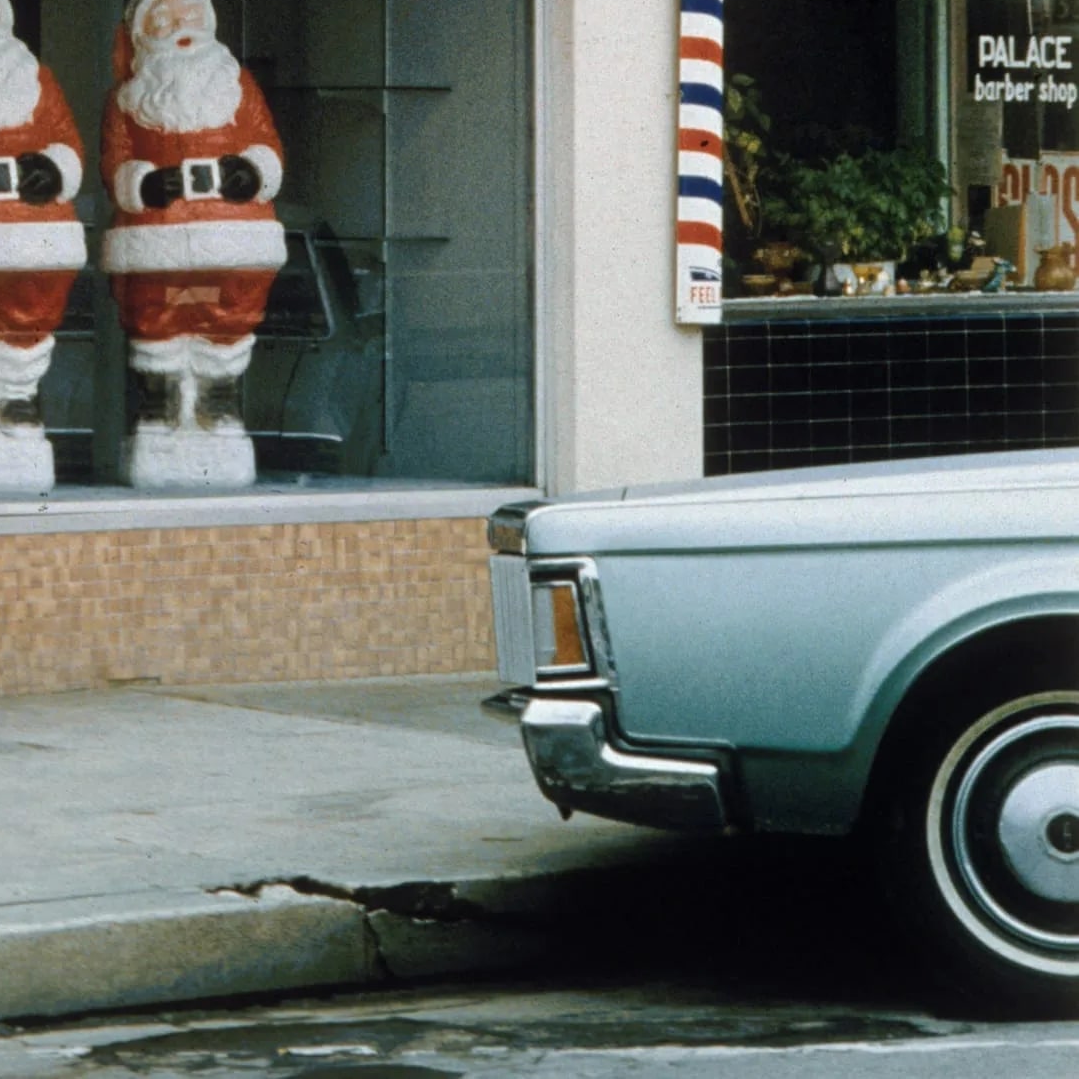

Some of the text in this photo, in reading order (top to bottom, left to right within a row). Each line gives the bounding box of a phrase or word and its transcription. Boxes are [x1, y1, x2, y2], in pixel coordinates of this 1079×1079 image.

[978, 35, 1073, 70] PALACE
[974, 72, 1078, 110] barber shop
